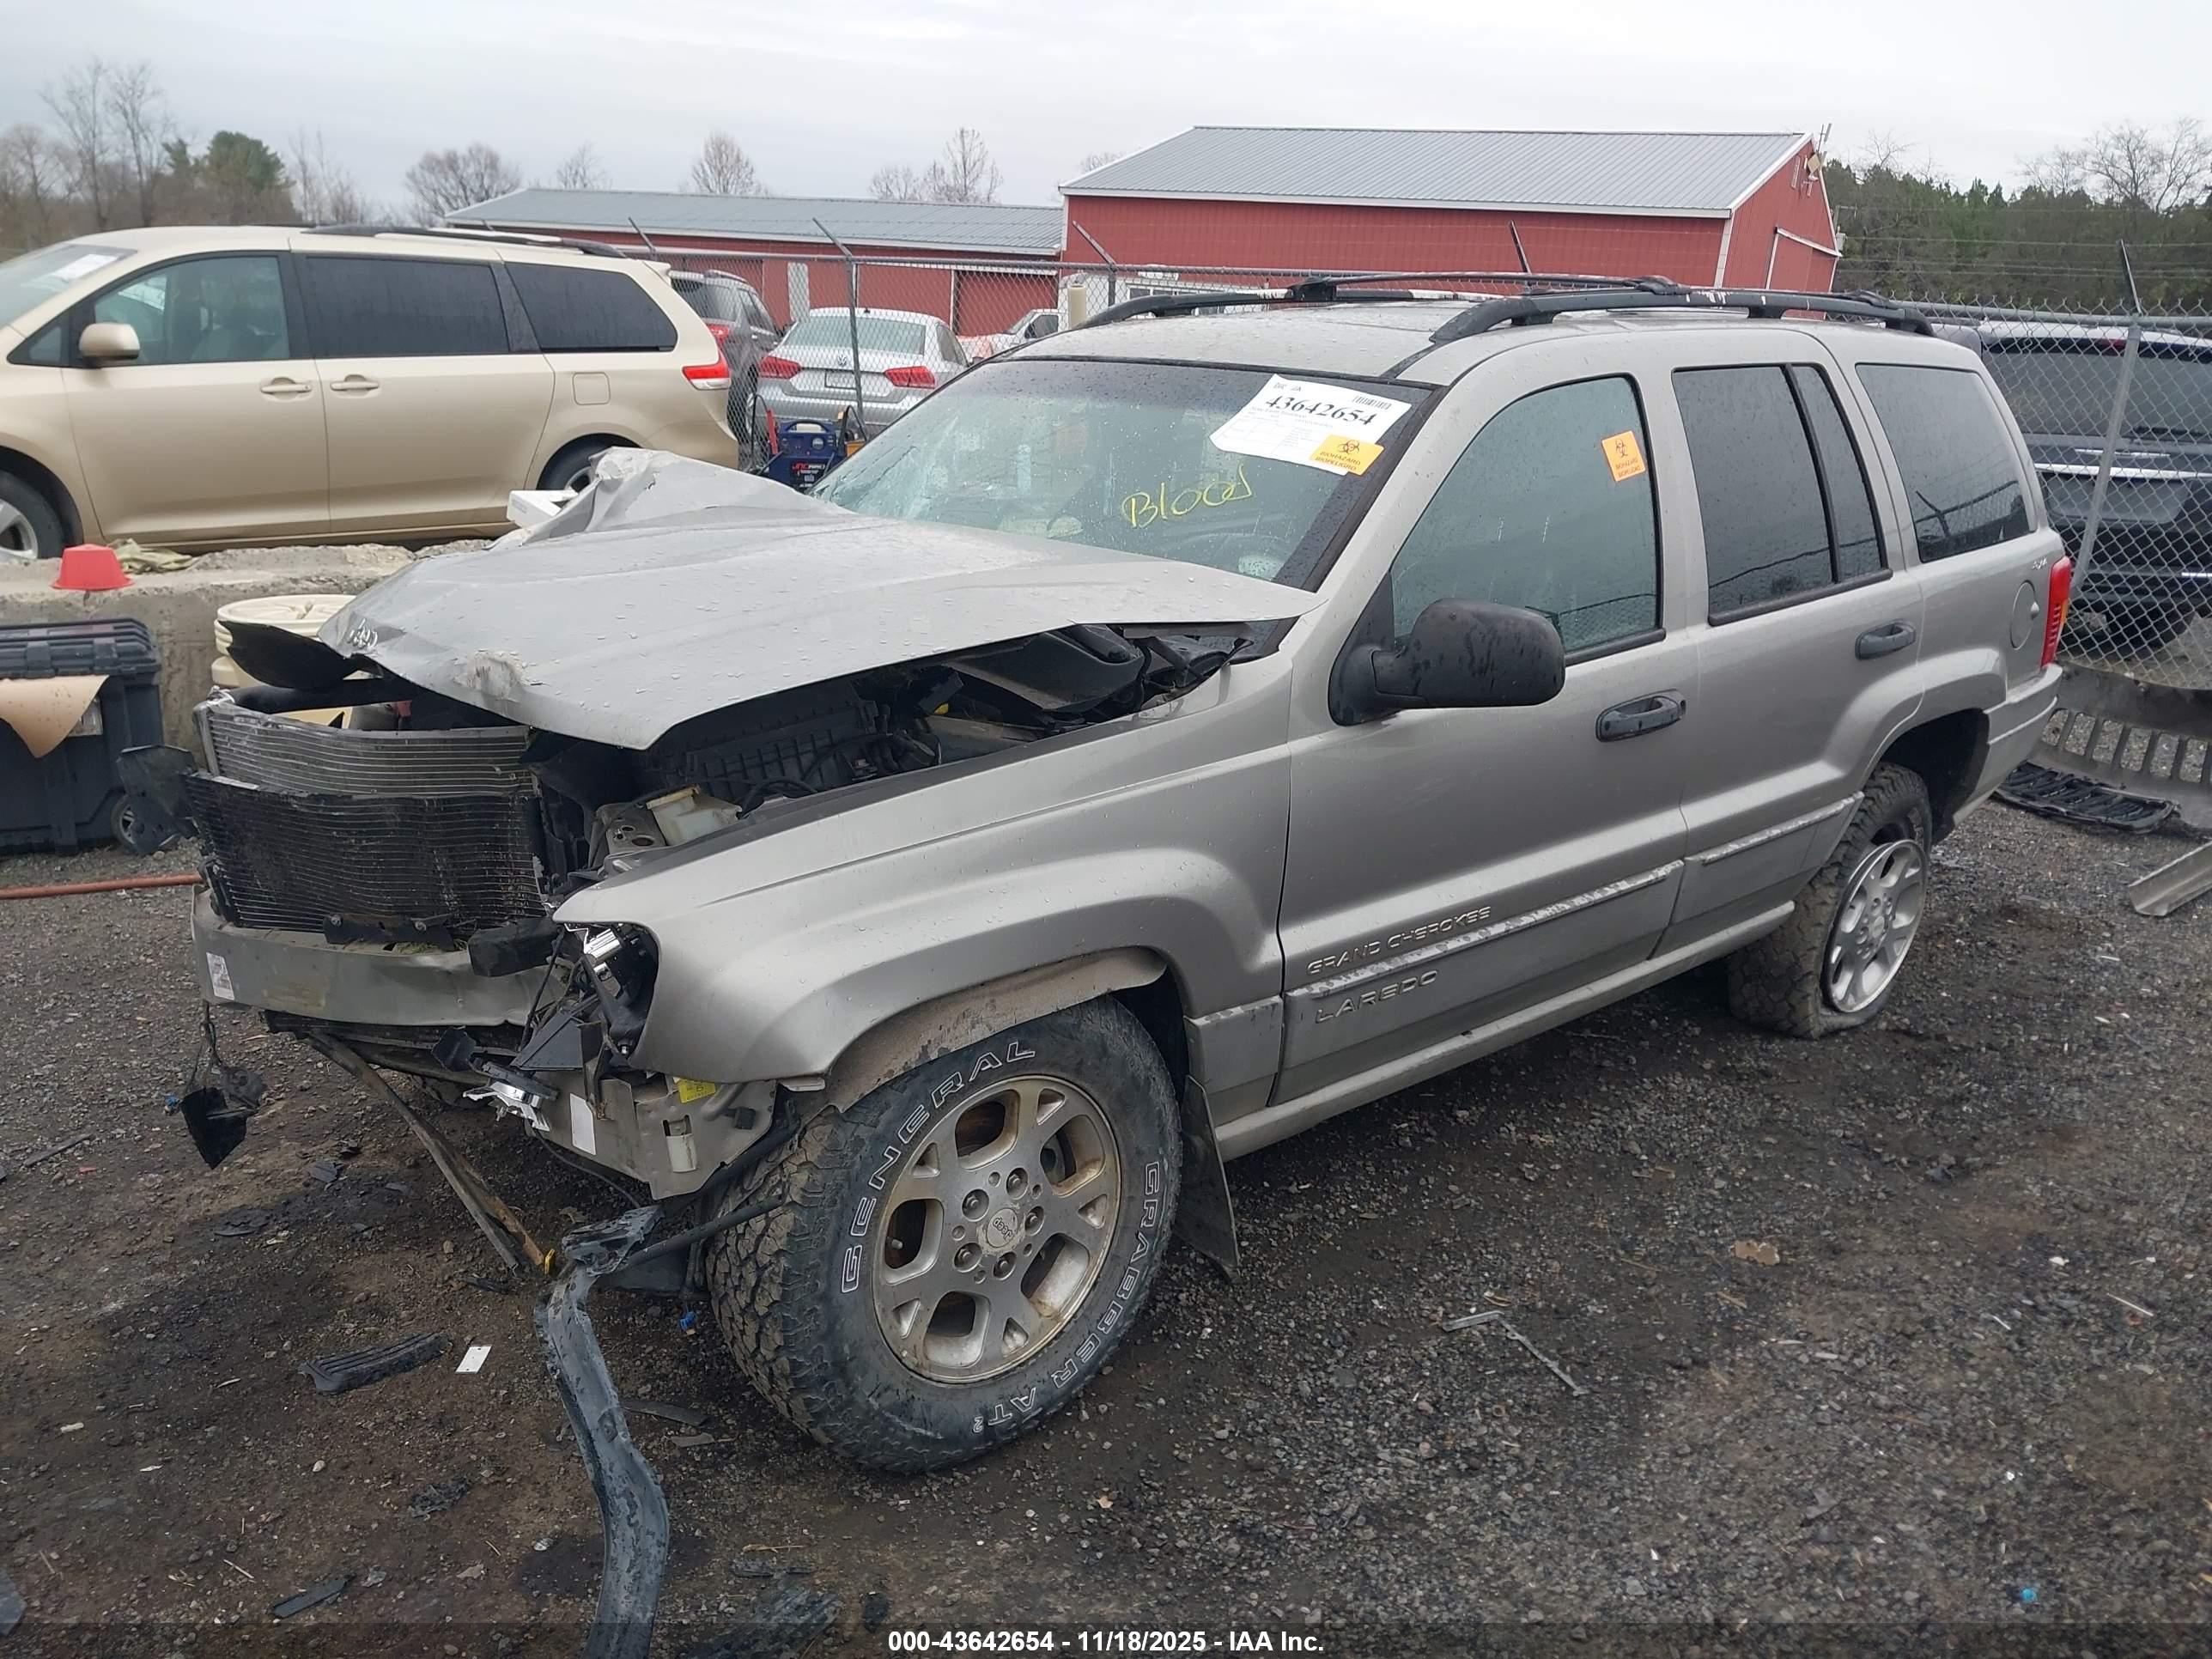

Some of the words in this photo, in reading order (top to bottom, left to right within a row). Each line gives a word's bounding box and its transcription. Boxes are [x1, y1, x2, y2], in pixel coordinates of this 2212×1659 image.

[1266, 395, 1377, 426] 43642654
[1319, 451, 1361, 466] BIOHAZARD
[1307, 941, 1382, 975] GRAND
[1387, 906, 1492, 949] CHEROKEE
[1315, 969, 1438, 1024] LAREDO
[842, 1042, 1036, 1293] GENERAL
[1050, 1161, 1161, 1389] GRABBER
